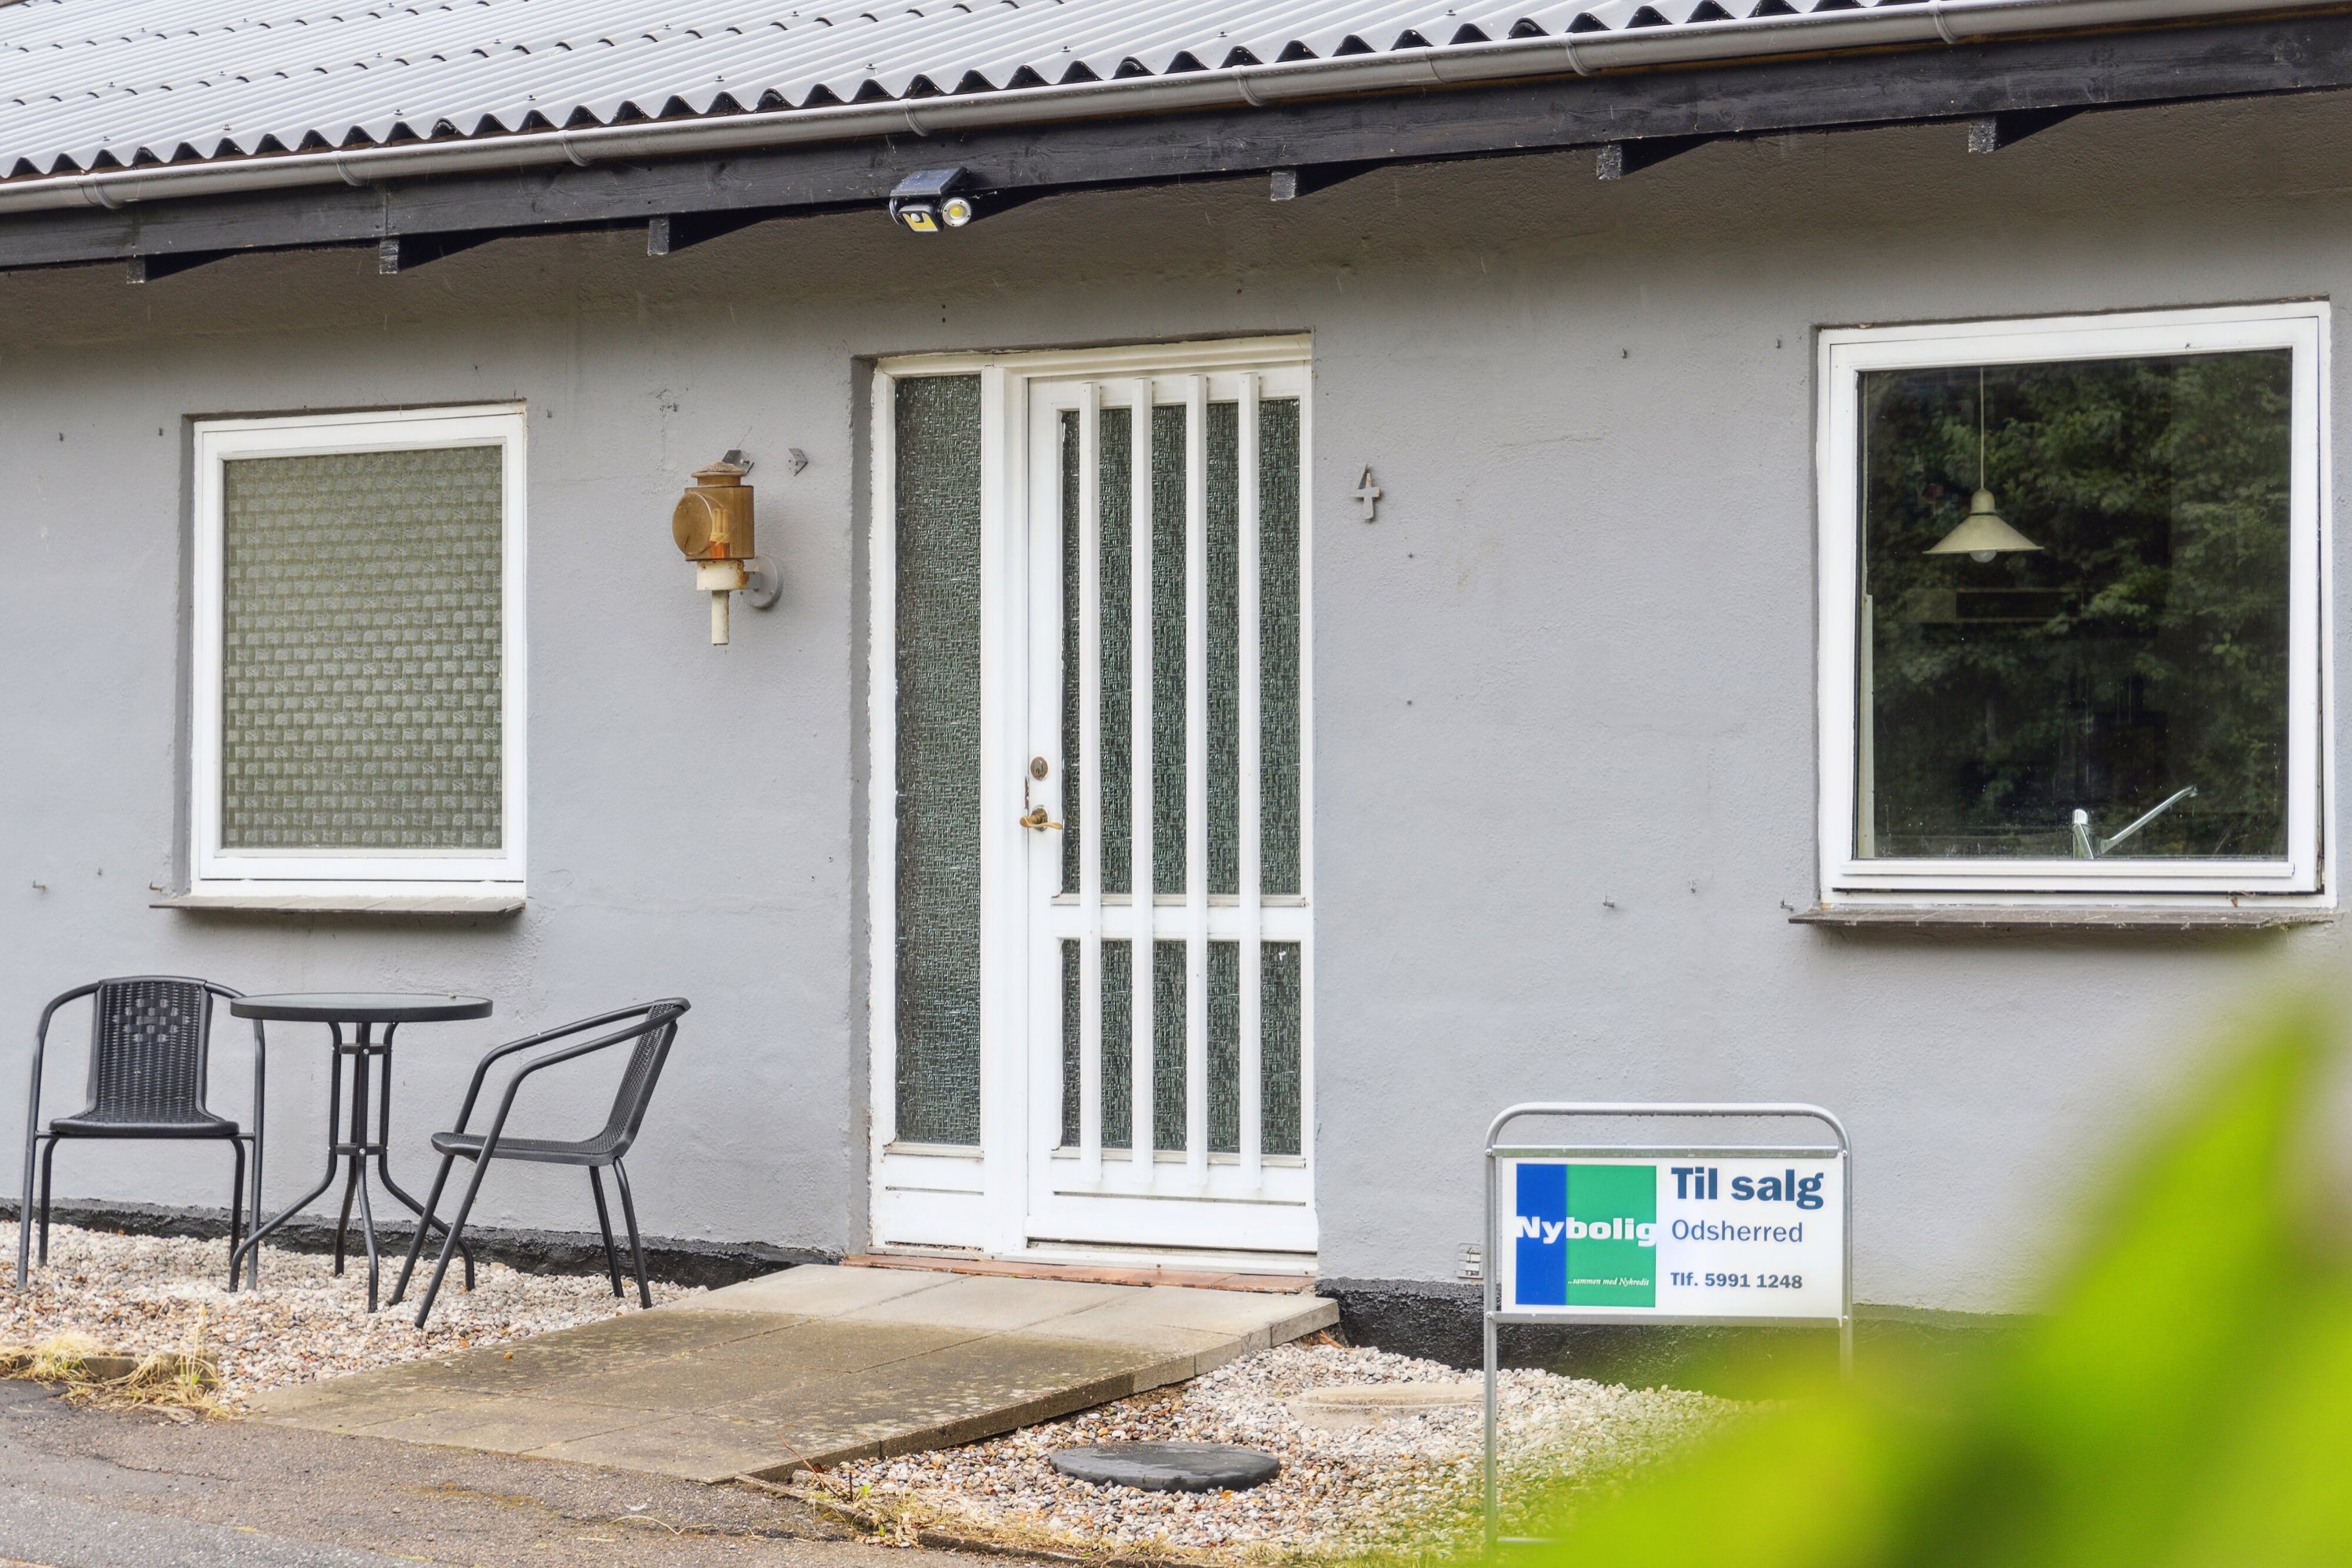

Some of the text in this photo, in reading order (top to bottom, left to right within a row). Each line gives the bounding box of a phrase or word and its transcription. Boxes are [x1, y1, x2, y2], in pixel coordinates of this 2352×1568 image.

[1353, 463, 1381, 521] 4
[1671, 1167, 1824, 1210] Til salg
[1516, 1216, 1657, 1247] Nybolig
[1671, 1219, 1802, 1243] Odsherred
[1602, 1277, 1617, 1286] med
[1618, 1277, 1650, 1287] Nykredit
[1670, 1272, 1803, 1289] Tlf. 5991 1248
